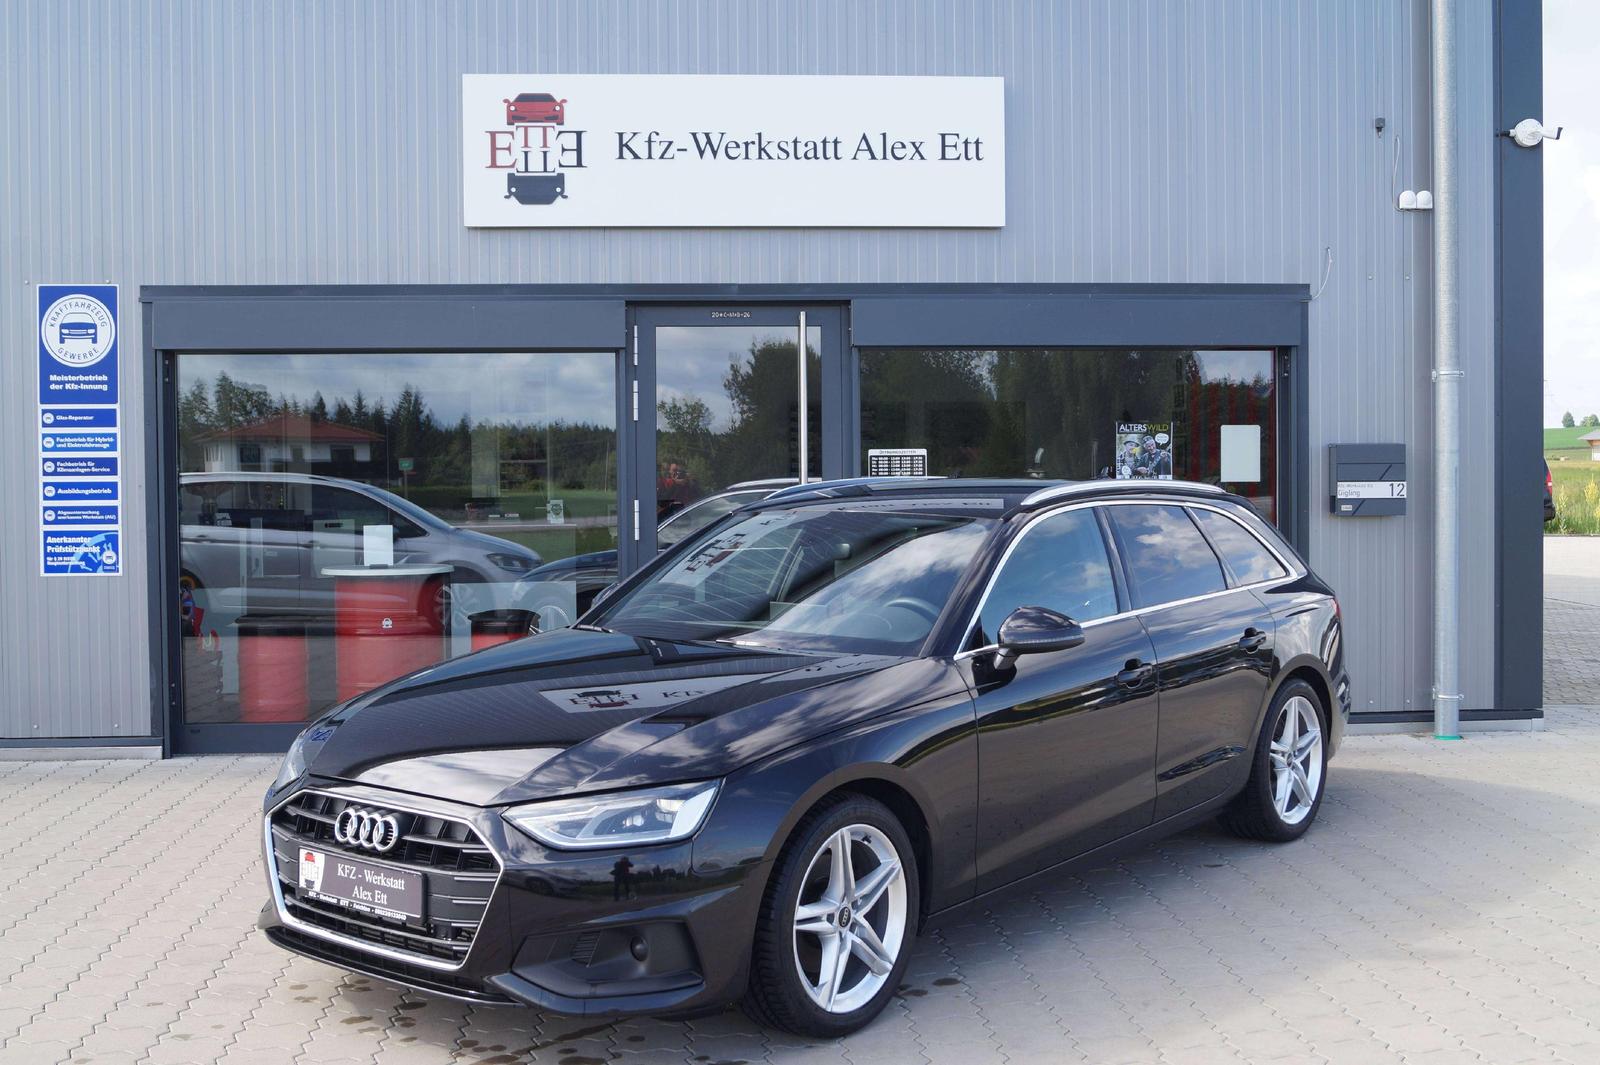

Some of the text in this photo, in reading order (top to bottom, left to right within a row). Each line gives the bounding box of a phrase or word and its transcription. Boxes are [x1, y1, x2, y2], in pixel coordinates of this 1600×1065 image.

[614, 131, 984, 162] Kfz-Werkstatt Alex Ett
[49, 301, 108, 328] KRAFTFAHRZEUG
[57, 347, 100, 360] GEWERBE
[49, 374, 108, 382] Meisterbetrieb
[65, 383, 108, 391] Kfz-Innung
[1389, 483, 1405, 497] 12
[337, 863, 357, 880] KFZ
[364, 869, 405, 891] Werkstatt
[352, 885, 388, 905] Alex Ett
